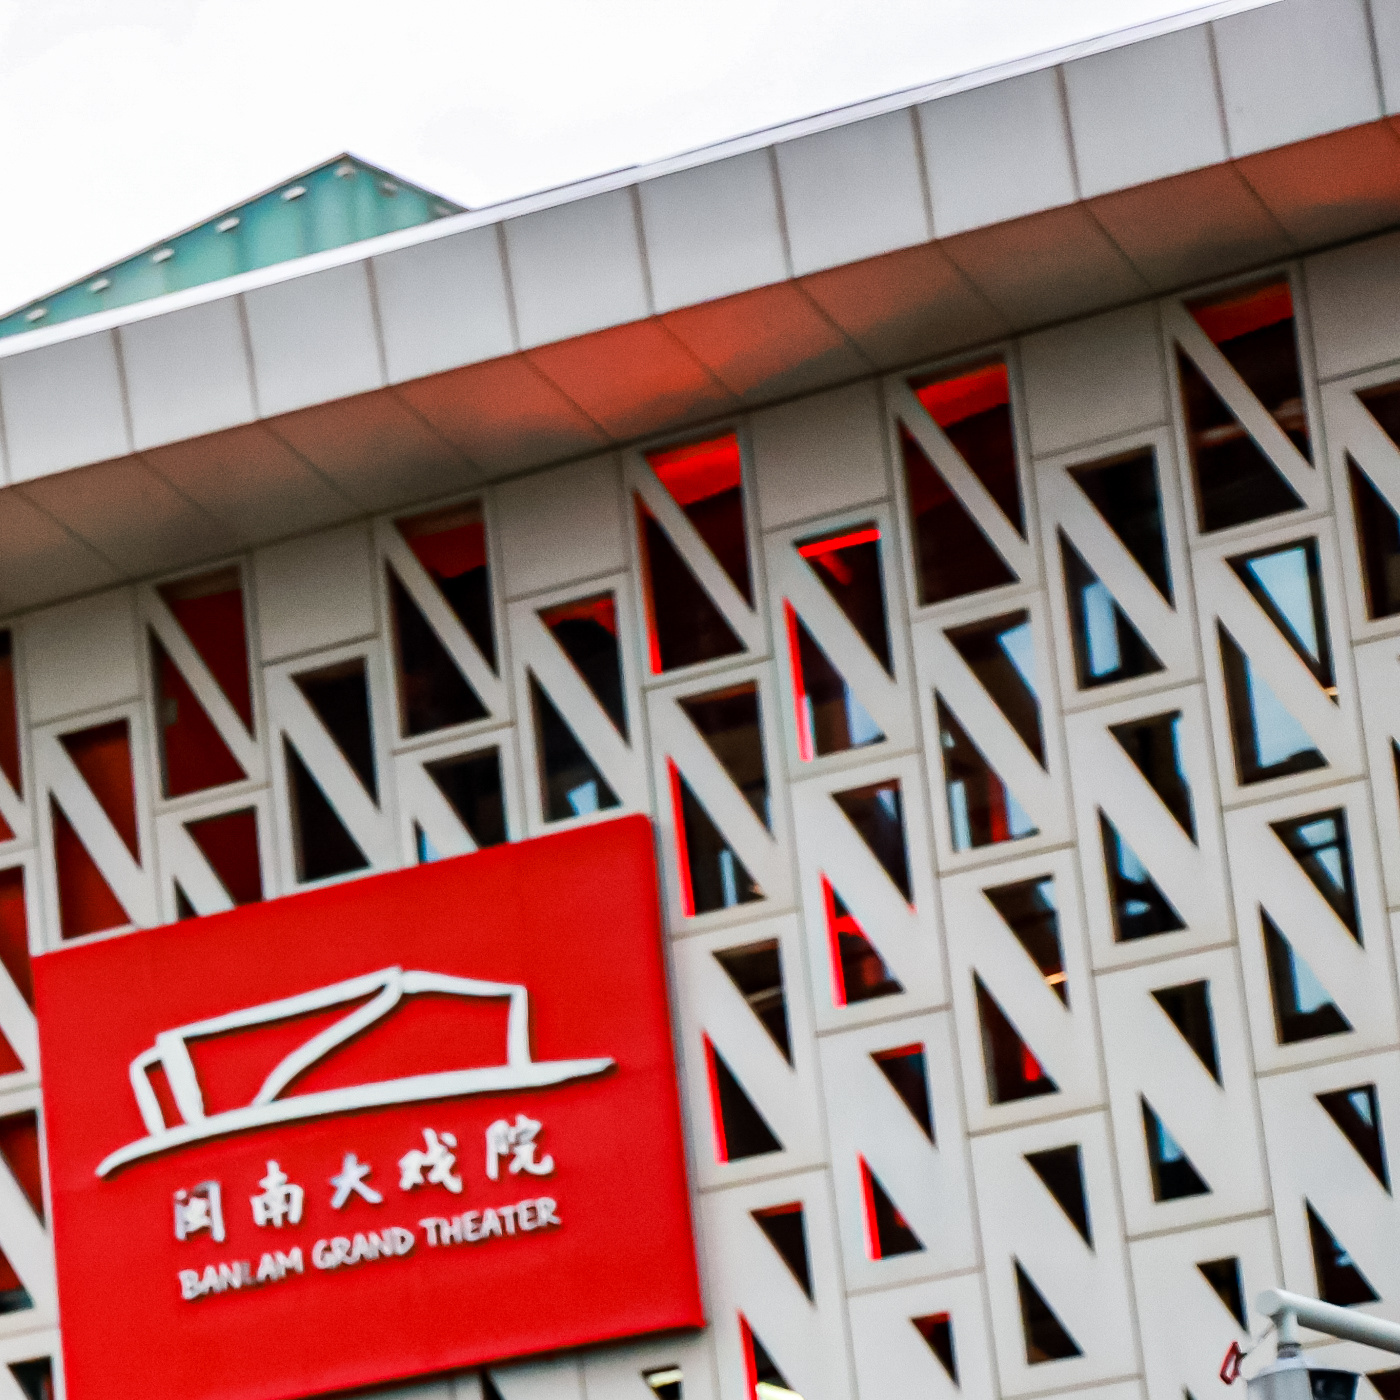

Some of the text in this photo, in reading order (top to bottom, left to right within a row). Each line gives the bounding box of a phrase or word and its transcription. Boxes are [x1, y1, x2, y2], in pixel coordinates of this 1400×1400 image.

[173, 1114, 554, 1243] 闽南大戏院
[178, 1197, 561, 1300] BANLAM GRAND THEATER
